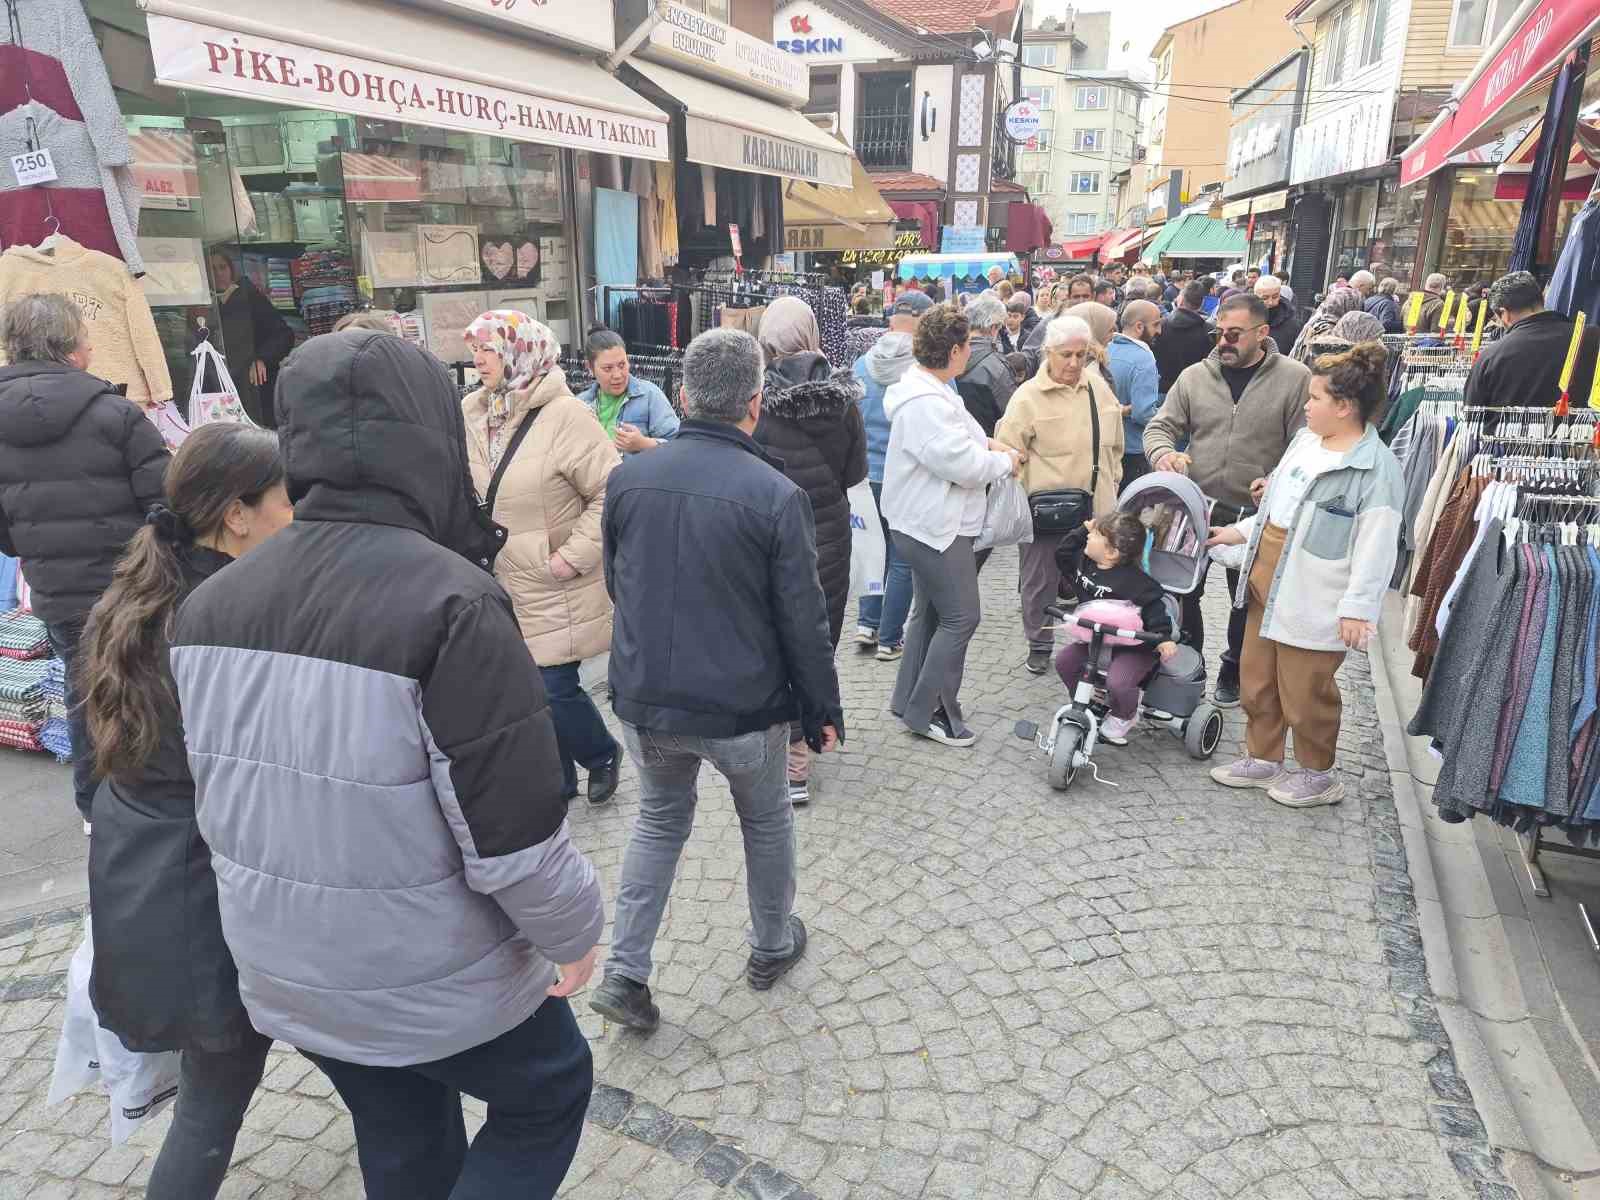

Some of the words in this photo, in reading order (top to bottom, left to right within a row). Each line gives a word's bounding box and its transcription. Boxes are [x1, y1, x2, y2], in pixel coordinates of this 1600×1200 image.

[664, 6, 695, 32] ENAZE
[777, 37, 842, 54] ESKIN
[202, 37, 593, 138] PİKE-BOHÇA-HURÇ-HAMAM
[597, 119, 657, 149] TAKIMI
[15, 153, 47, 173] 250
